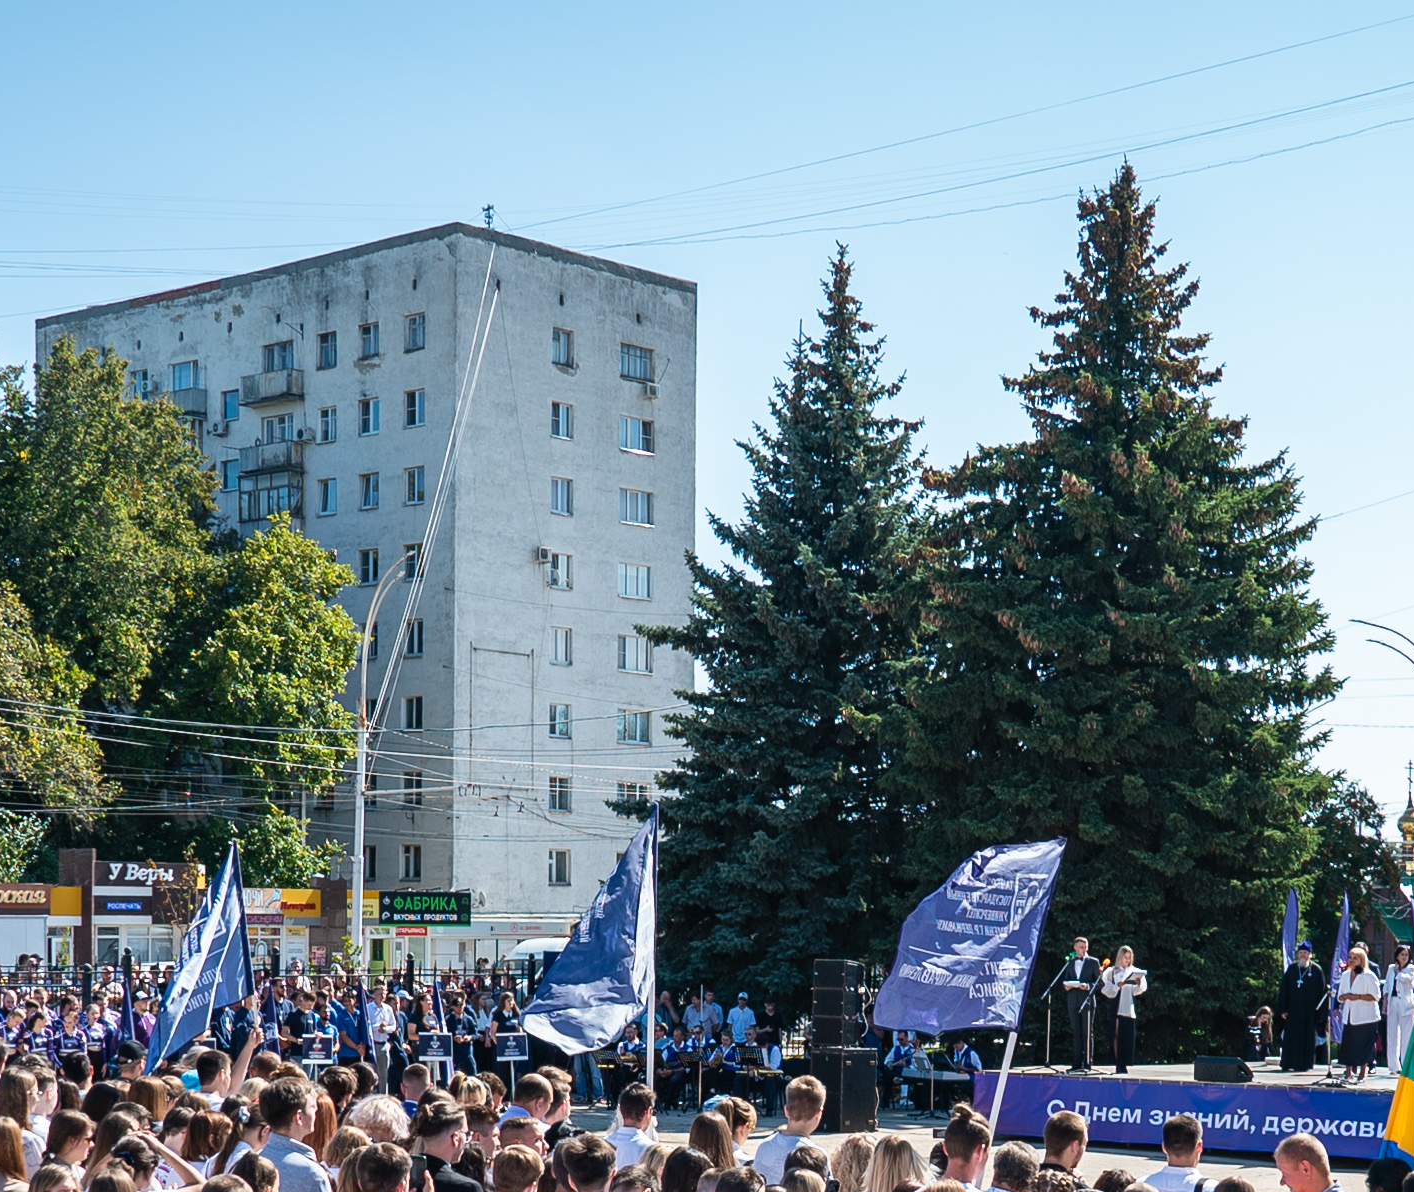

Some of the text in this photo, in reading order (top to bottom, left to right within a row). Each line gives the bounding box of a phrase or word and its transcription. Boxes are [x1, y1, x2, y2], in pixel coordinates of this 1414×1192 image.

[108, 863, 175, 885] У Веры
[394, 896, 457, 911] ФАБРИКА
[1046, 1099, 1066, 1116] С
[1074, 1101, 1142, 1125] Днем
